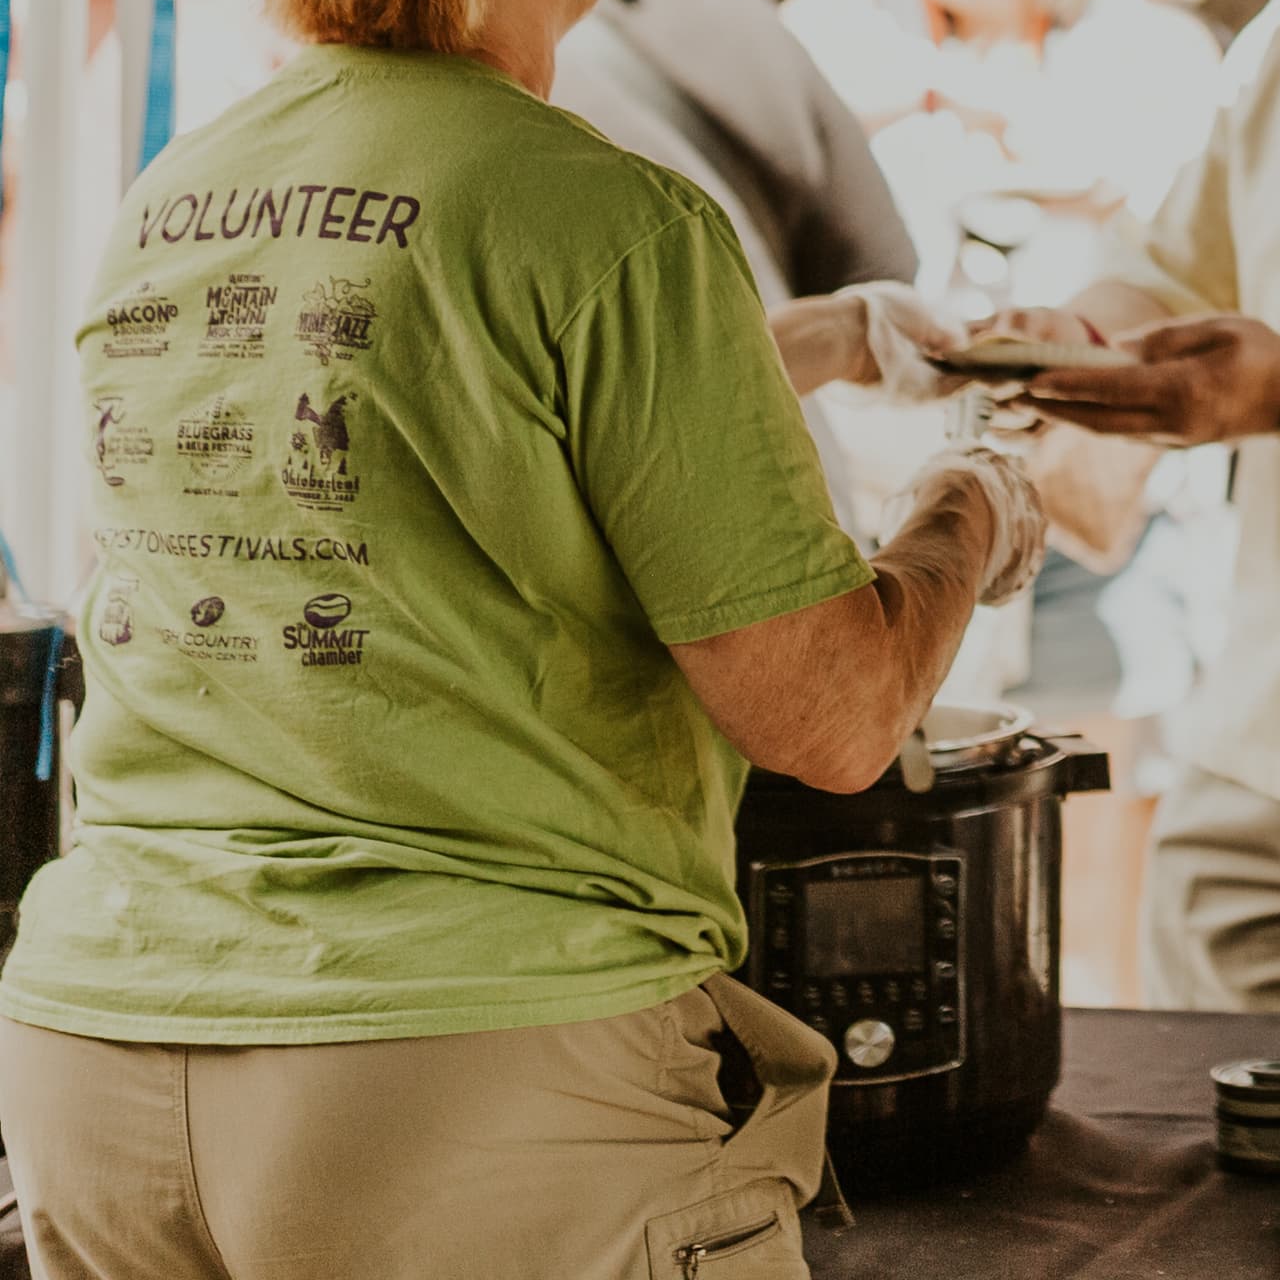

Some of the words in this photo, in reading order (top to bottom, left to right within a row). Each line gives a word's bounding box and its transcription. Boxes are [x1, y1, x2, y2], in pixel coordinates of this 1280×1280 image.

[139, 185, 420, 249] VOLUNTEER
[206, 286, 278, 312] MOUNTAIN
[107, 304, 178, 325] BACON
[177, 425, 254, 441] BLUEGRASS
[183, 632, 260, 649] COUNTRY
[283, 625, 370, 649] SUMMIT
[301, 649, 362, 667] chamber
